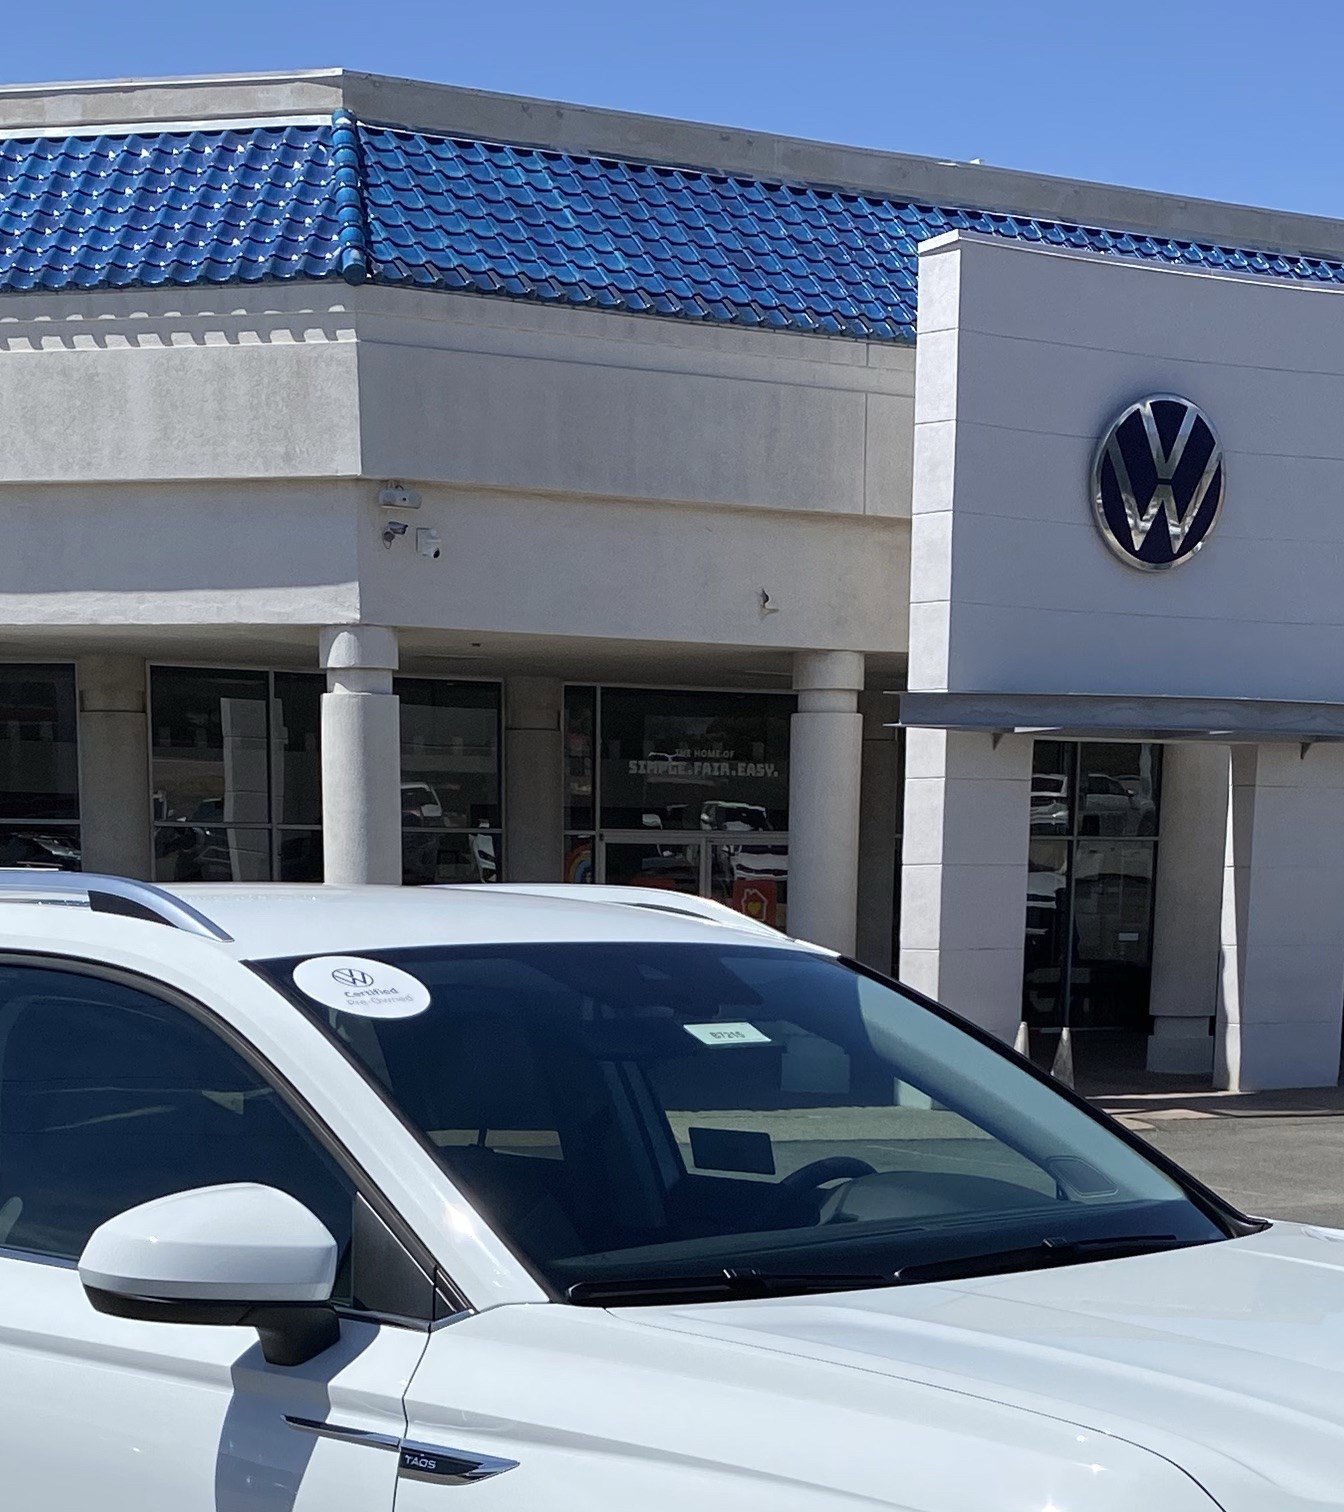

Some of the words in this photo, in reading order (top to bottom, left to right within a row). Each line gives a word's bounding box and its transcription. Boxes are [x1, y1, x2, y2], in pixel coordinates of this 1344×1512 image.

[1099, 396, 1224, 562] VW
[694, 749, 721, 758] HOME
[723, 750, 735, 758] OF
[344, 987, 398, 998] Certified
[405, 1455, 436, 1469] TAOS
